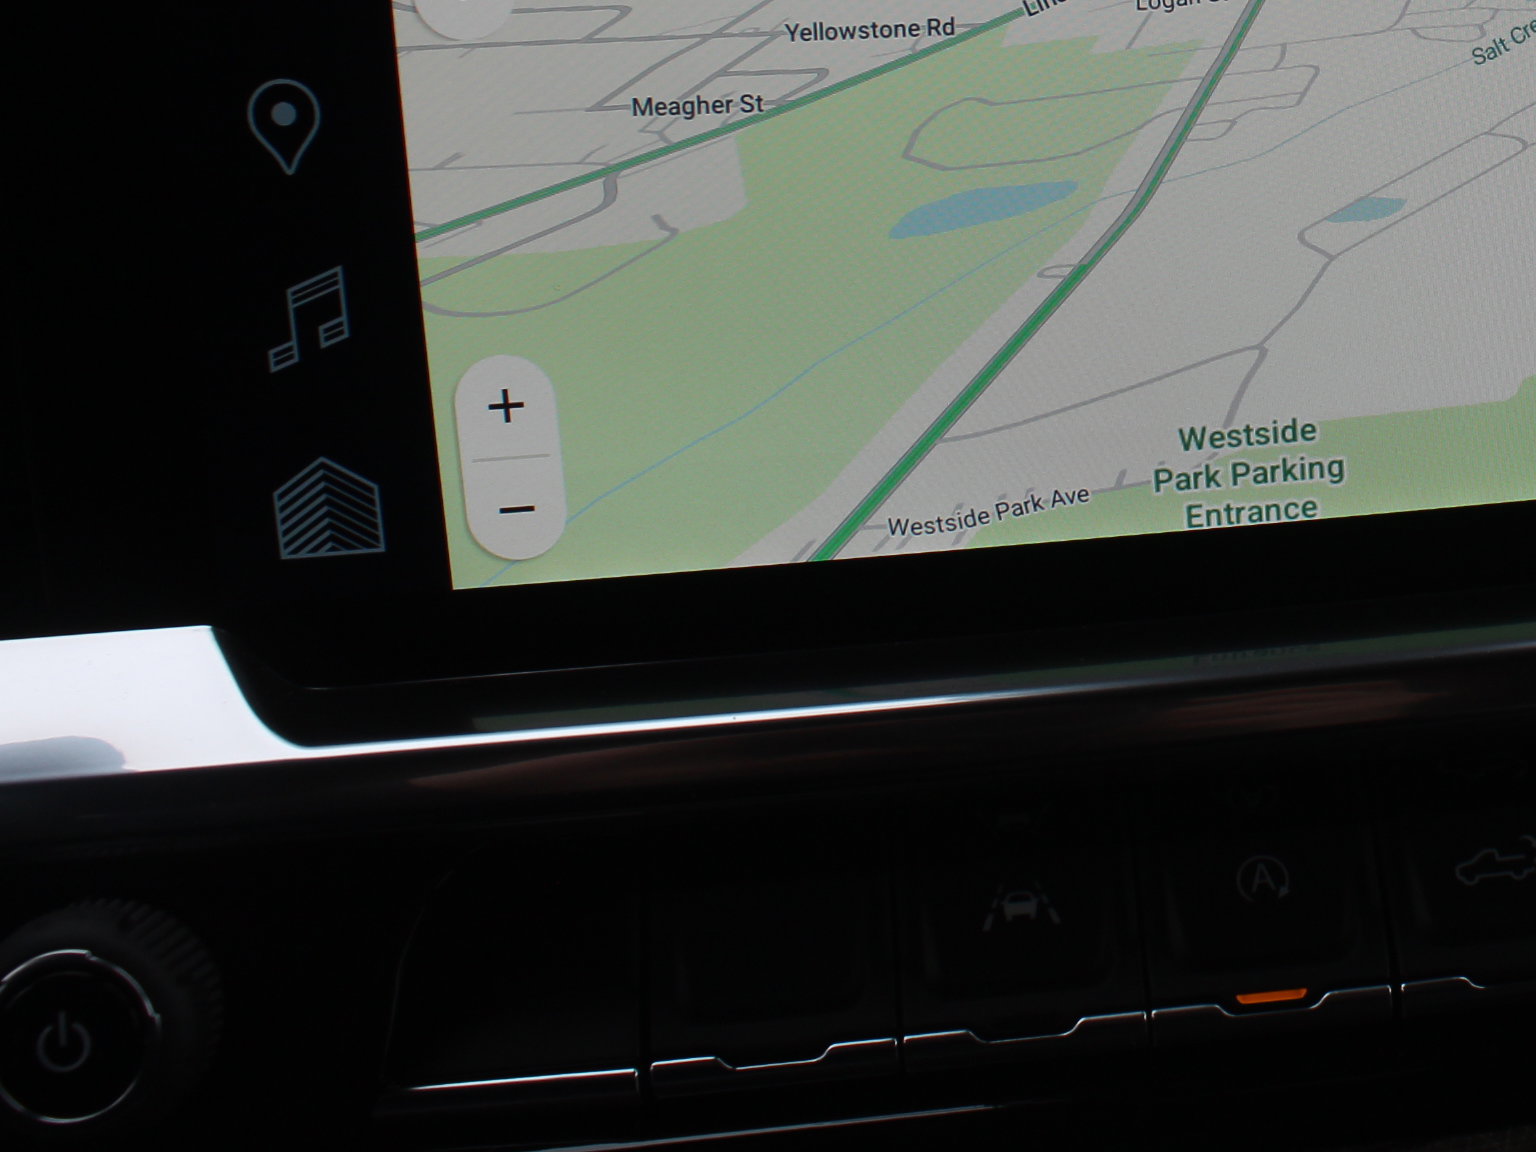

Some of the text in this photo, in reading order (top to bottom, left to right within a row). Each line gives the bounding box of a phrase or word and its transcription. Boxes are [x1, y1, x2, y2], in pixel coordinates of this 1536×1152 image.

[785, 16, 956, 43] Yellowstone Rd
[1471, 38, 1513, 67] Salt
[632, 94, 765, 120] Meagher St
[1178, 418, 1318, 452] Westside
[1154, 455, 1345, 494] Park Parking
[887, 485, 1091, 539] Westside Park Ave
[1187, 498, 1319, 530] Entrance
